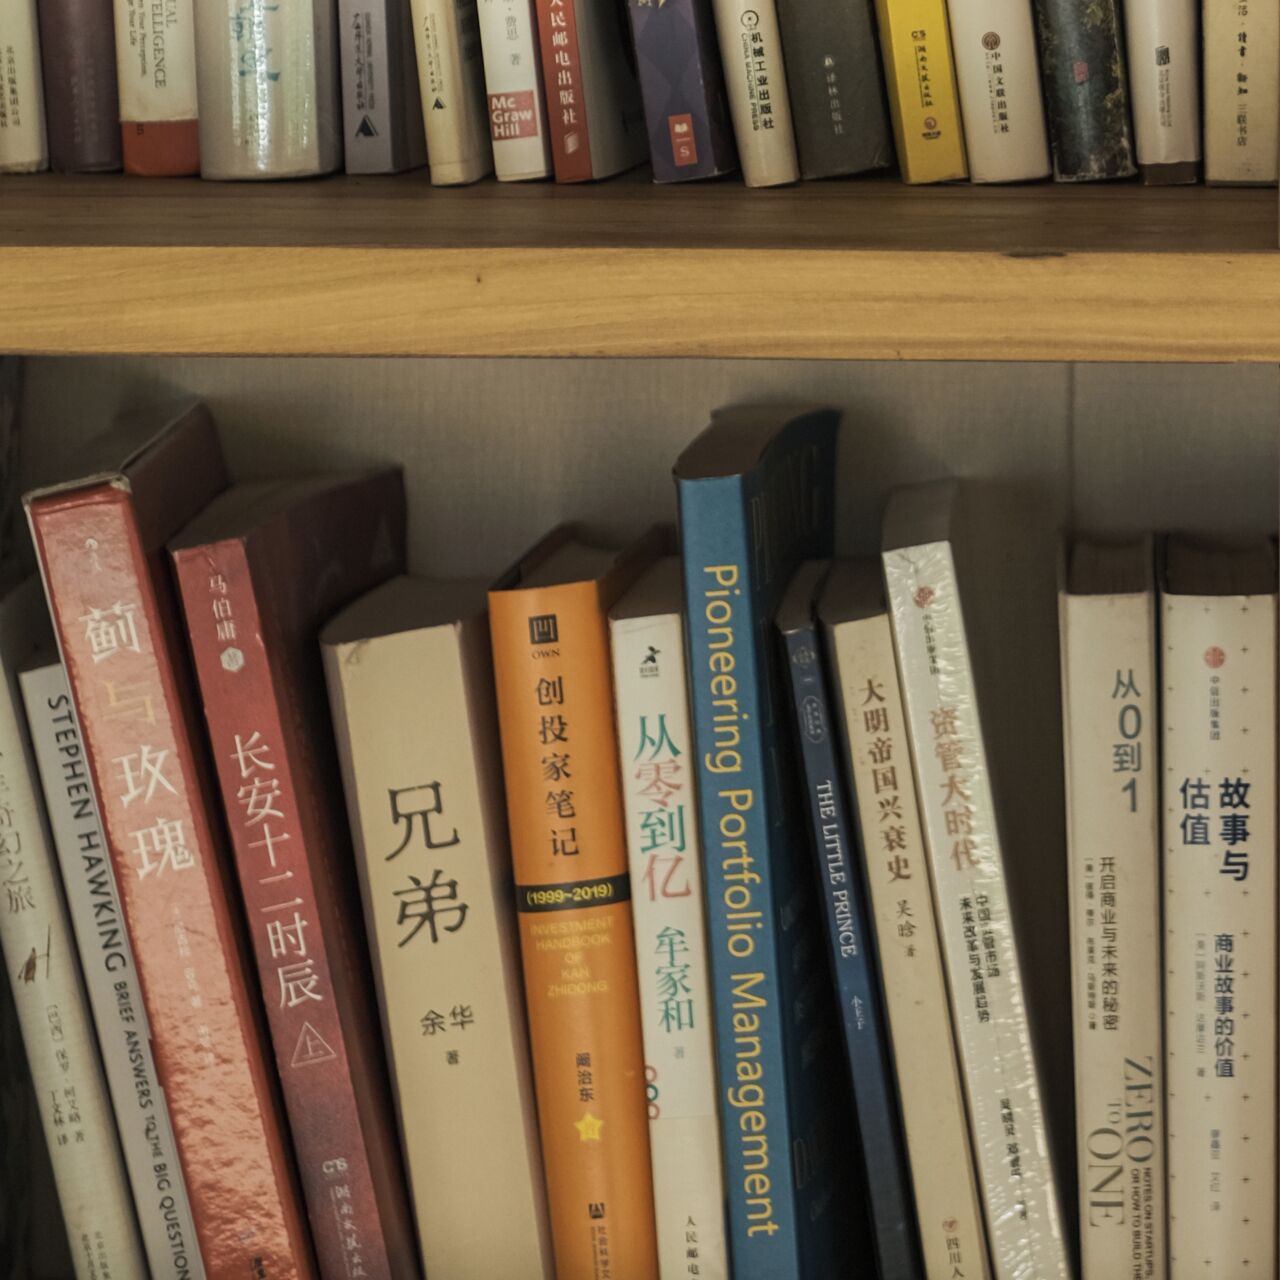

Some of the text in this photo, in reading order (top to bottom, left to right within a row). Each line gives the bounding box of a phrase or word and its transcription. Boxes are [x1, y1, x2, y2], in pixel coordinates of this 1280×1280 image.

[491, 96, 517, 109] Mc
[492, 109, 534, 123] Graw
[493, 123, 521, 138] Hill
[750, 31, 776, 131] 机械工业出版社
[208, 574, 237, 642] 马伯庸
[534, 675, 580, 857] 创投家笔记
[860, 677, 913, 882] 大明帝国兴衰史
[930, 707, 982, 872] 资管大时代
[1111, 668, 1142, 814] 从0到1
[47, 694, 129, 973] STEPHEN HAWKING
[632, 713, 692, 902] 从零到亿
[1179, 777, 1211, 847] 估值
[1217, 776, 1252, 882] 故事与
[230, 730, 323, 1010] 长安十二时辰
[385, 779, 470, 949] 兄弟
[703, 564, 780, 1238] Pioneering Portfolio Management
[816, 780, 858, 959] THE LITTLE PRINCE
[529, 916, 613, 934] INVESTMENT
[535, 934, 612, 951] HANDBOOK
[113, 981, 135, 1023] BRIEF
[420, 1003, 475, 1038] 余华
[654, 925, 695, 1034] 牟家和
[1214, 932, 1236, 1079] 商业故事的价值
[123, 1029, 153, 1110] ANSWERS
[1106, 1096, 1123, 1125] TO
[1123, 1055, 1154, 1163] ZERO
[153, 1163, 171, 1192] BIG
[1087, 1127, 1125, 1228] ONE
